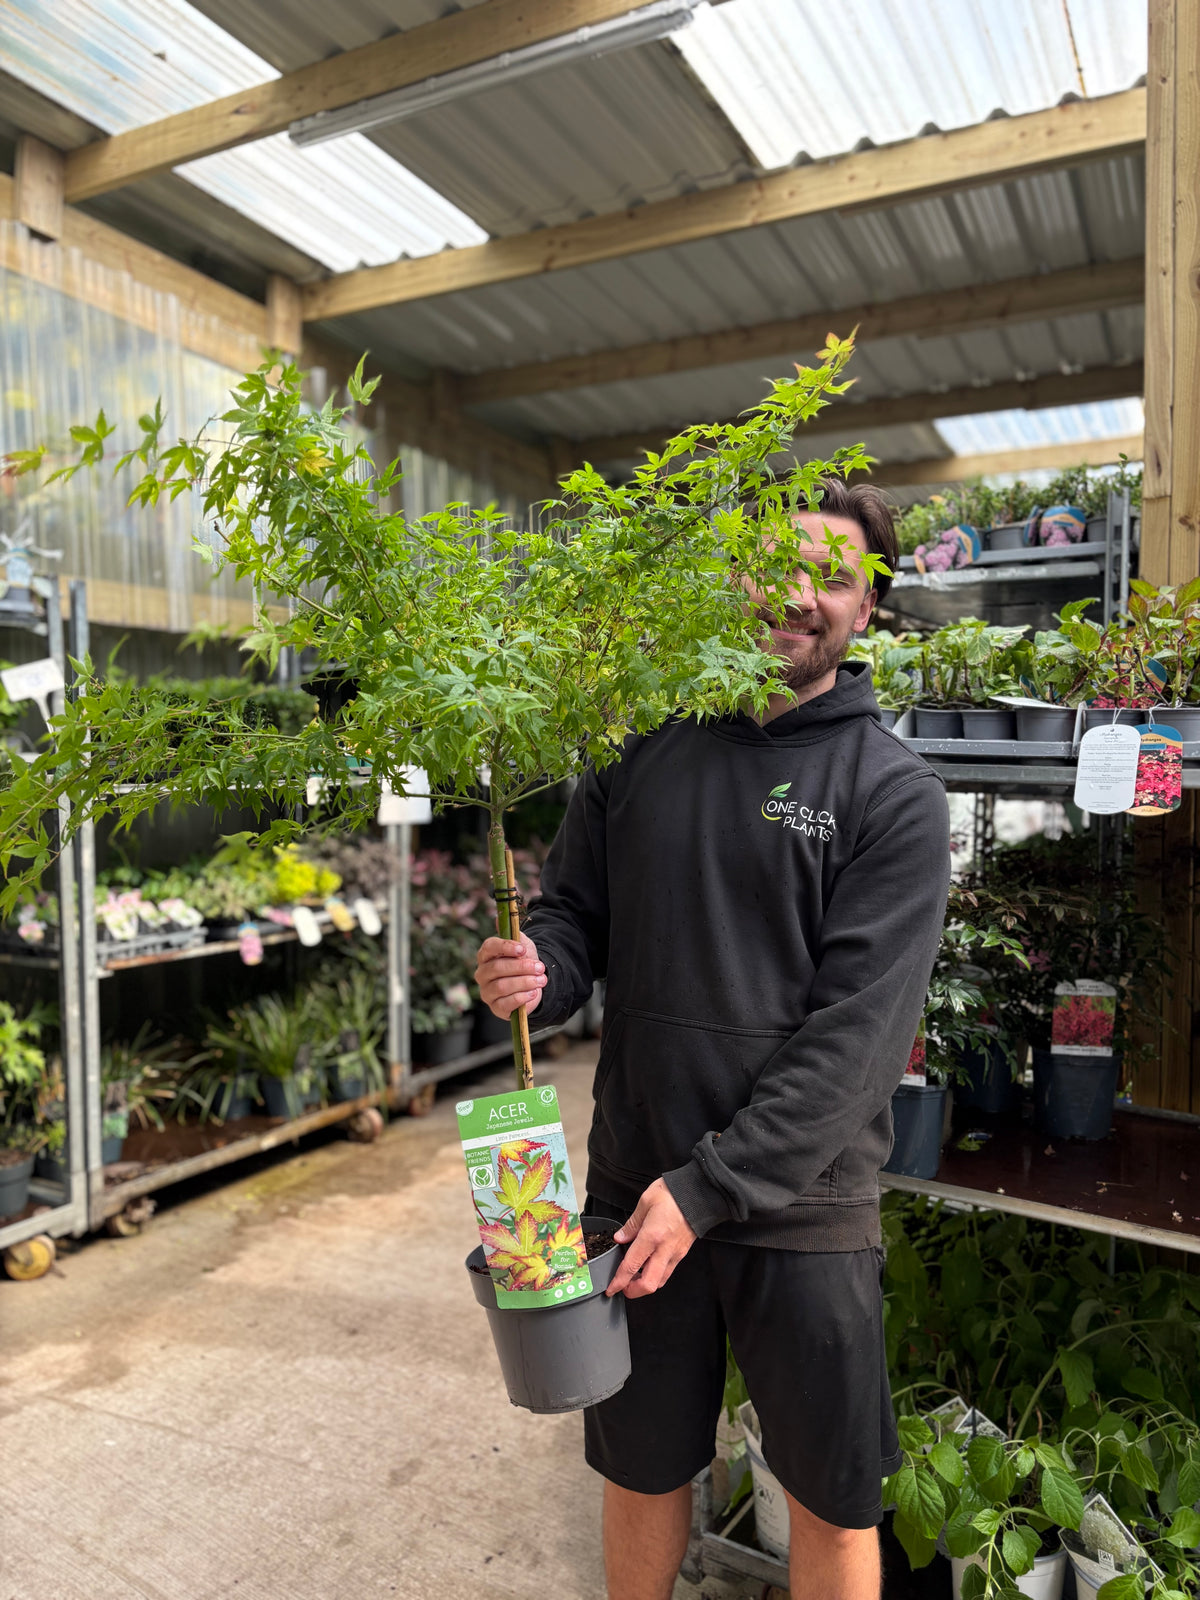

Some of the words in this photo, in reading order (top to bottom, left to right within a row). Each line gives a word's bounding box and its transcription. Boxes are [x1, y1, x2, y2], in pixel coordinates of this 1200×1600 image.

[766, 800, 798, 813] ONE
[799, 806, 836, 830] CLICK
[783, 816, 833, 841] PLANTS
[489, 1102, 528, 1121] ACER
[486, 1120, 513, 1130] Japanese
[514, 1116, 534, 1125] Jewels
[466, 1150, 490, 1159] BOTANIC
[468, 1156, 491, 1165] FRIENDS
